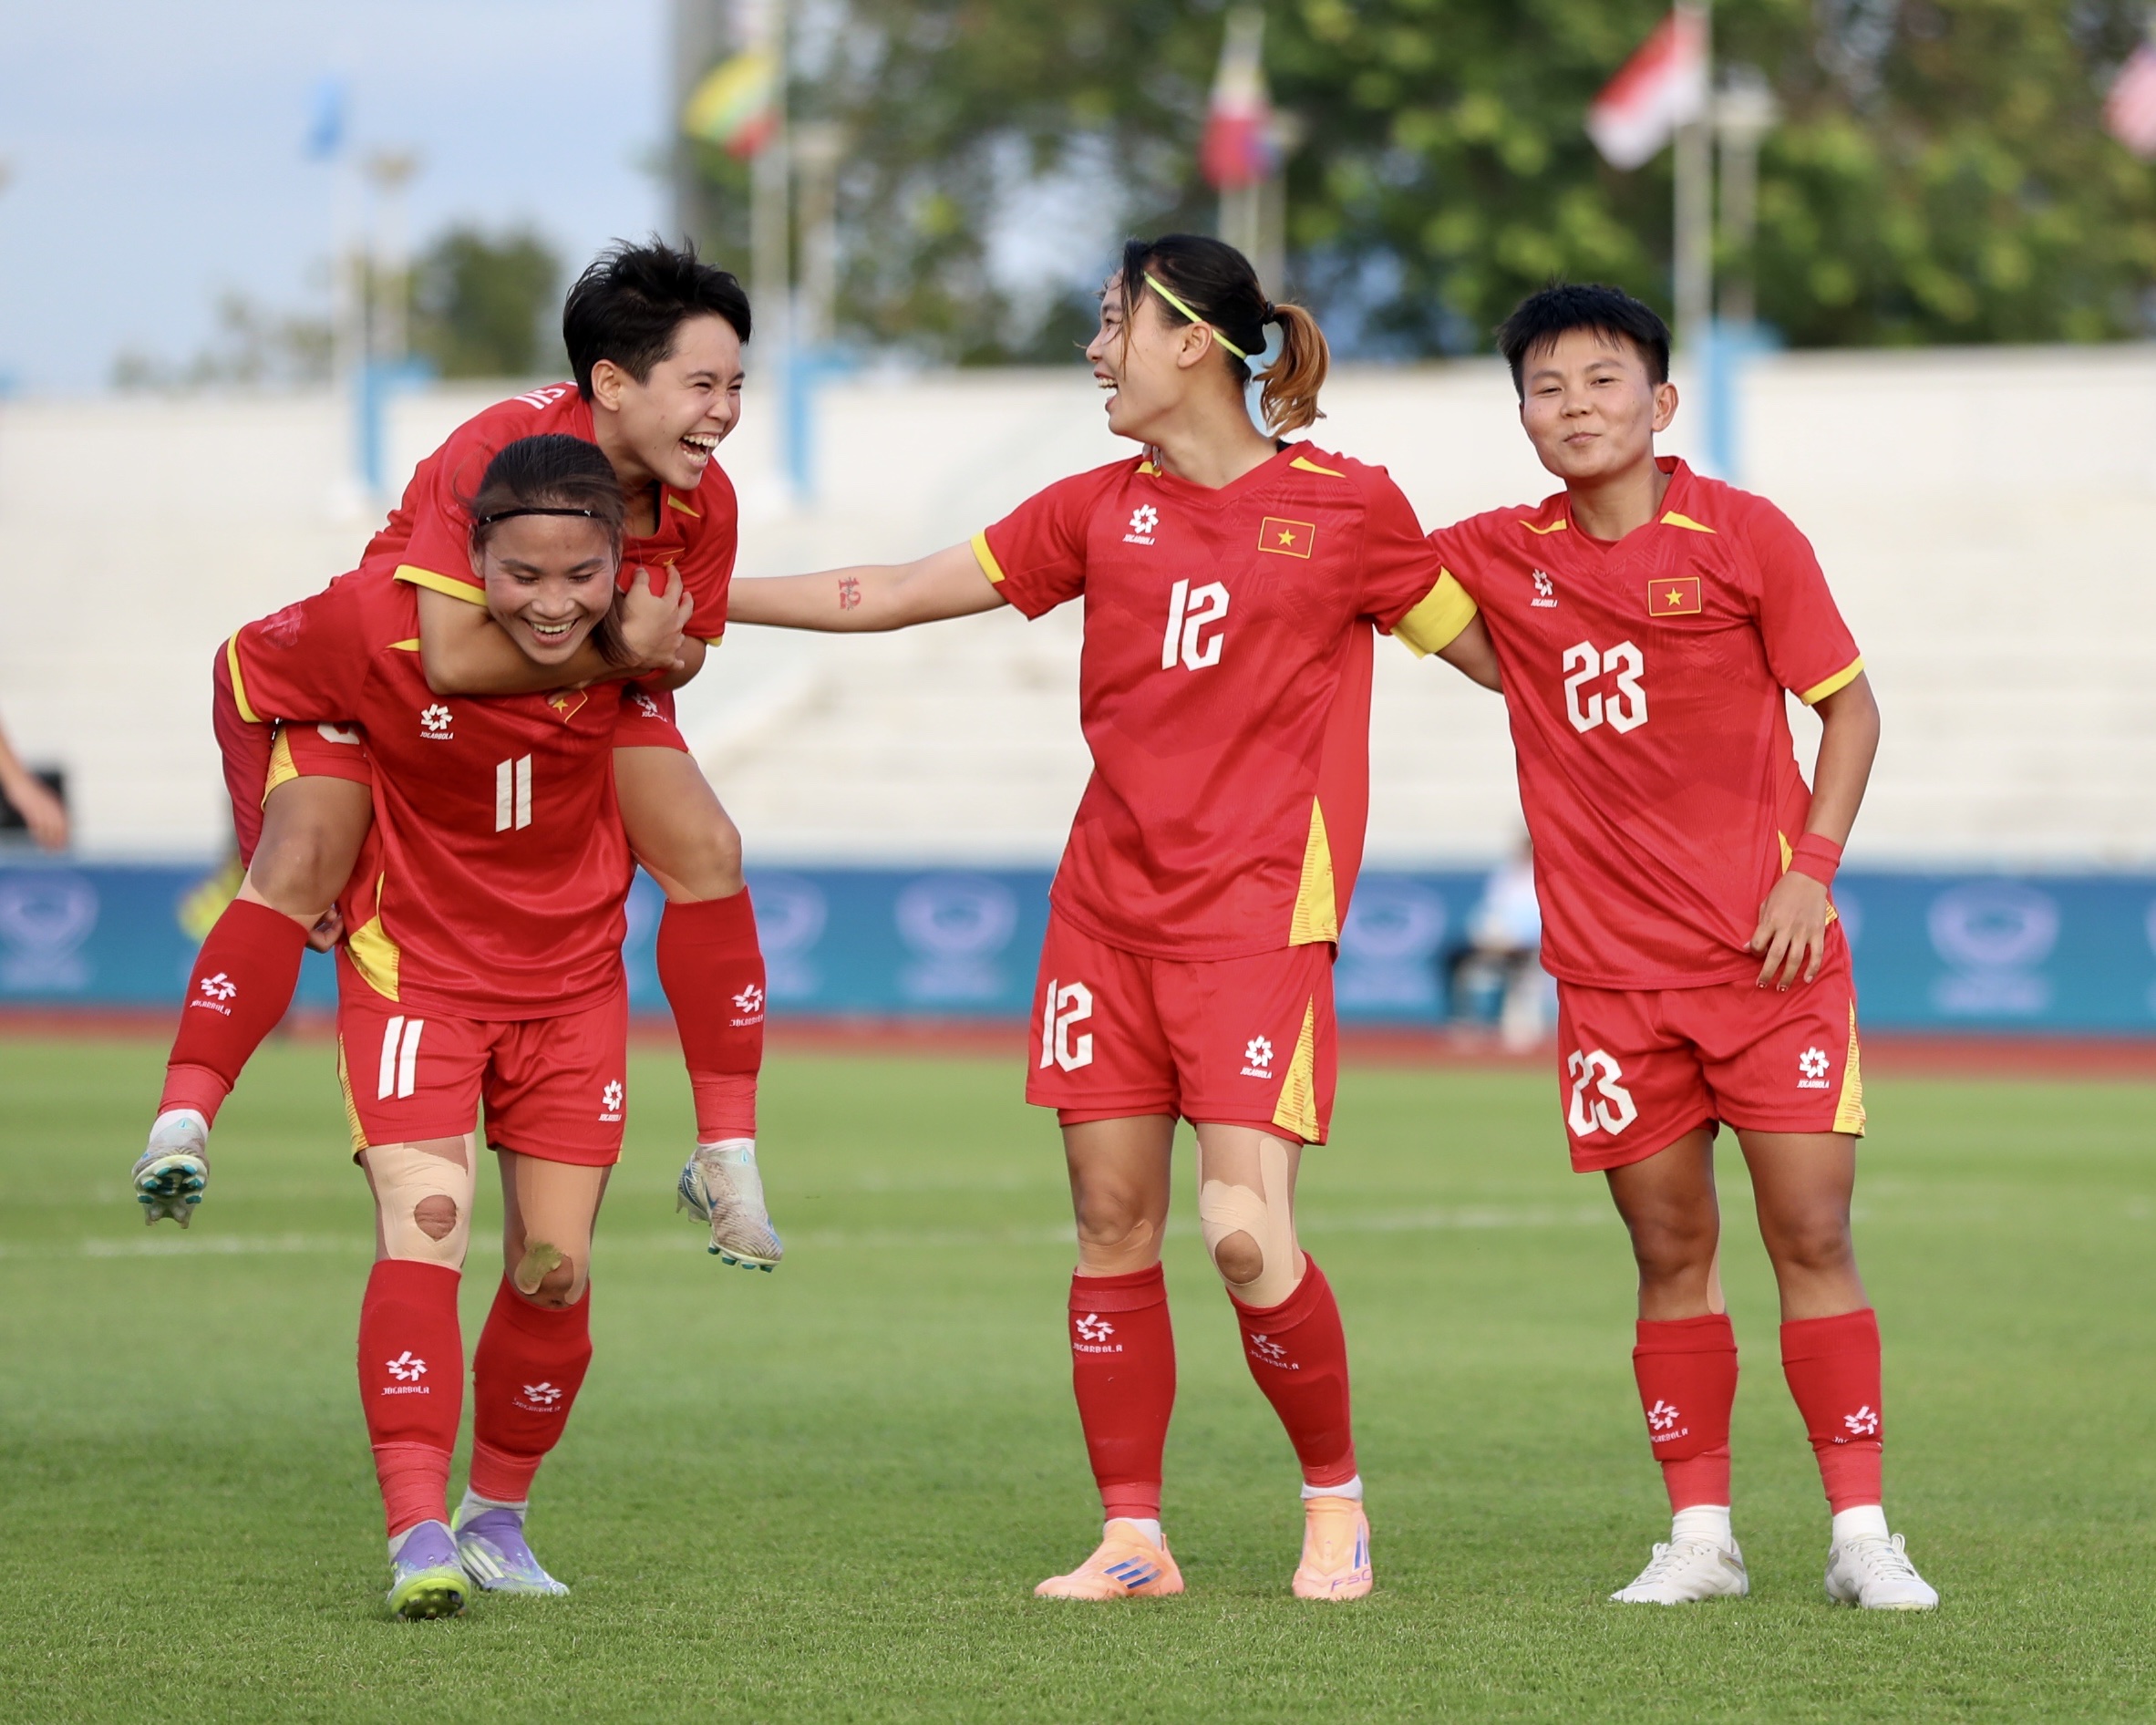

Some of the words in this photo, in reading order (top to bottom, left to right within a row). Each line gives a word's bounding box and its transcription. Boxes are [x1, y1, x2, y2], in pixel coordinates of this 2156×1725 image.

[1161, 577, 1231, 672] 12
[1562, 639, 1649, 735] 23
[495, 753, 532, 833] 11
[377, 1015, 426, 1101] 11
[1039, 978, 1094, 1073] 12
[1567, 1048, 1639, 1138] 23
